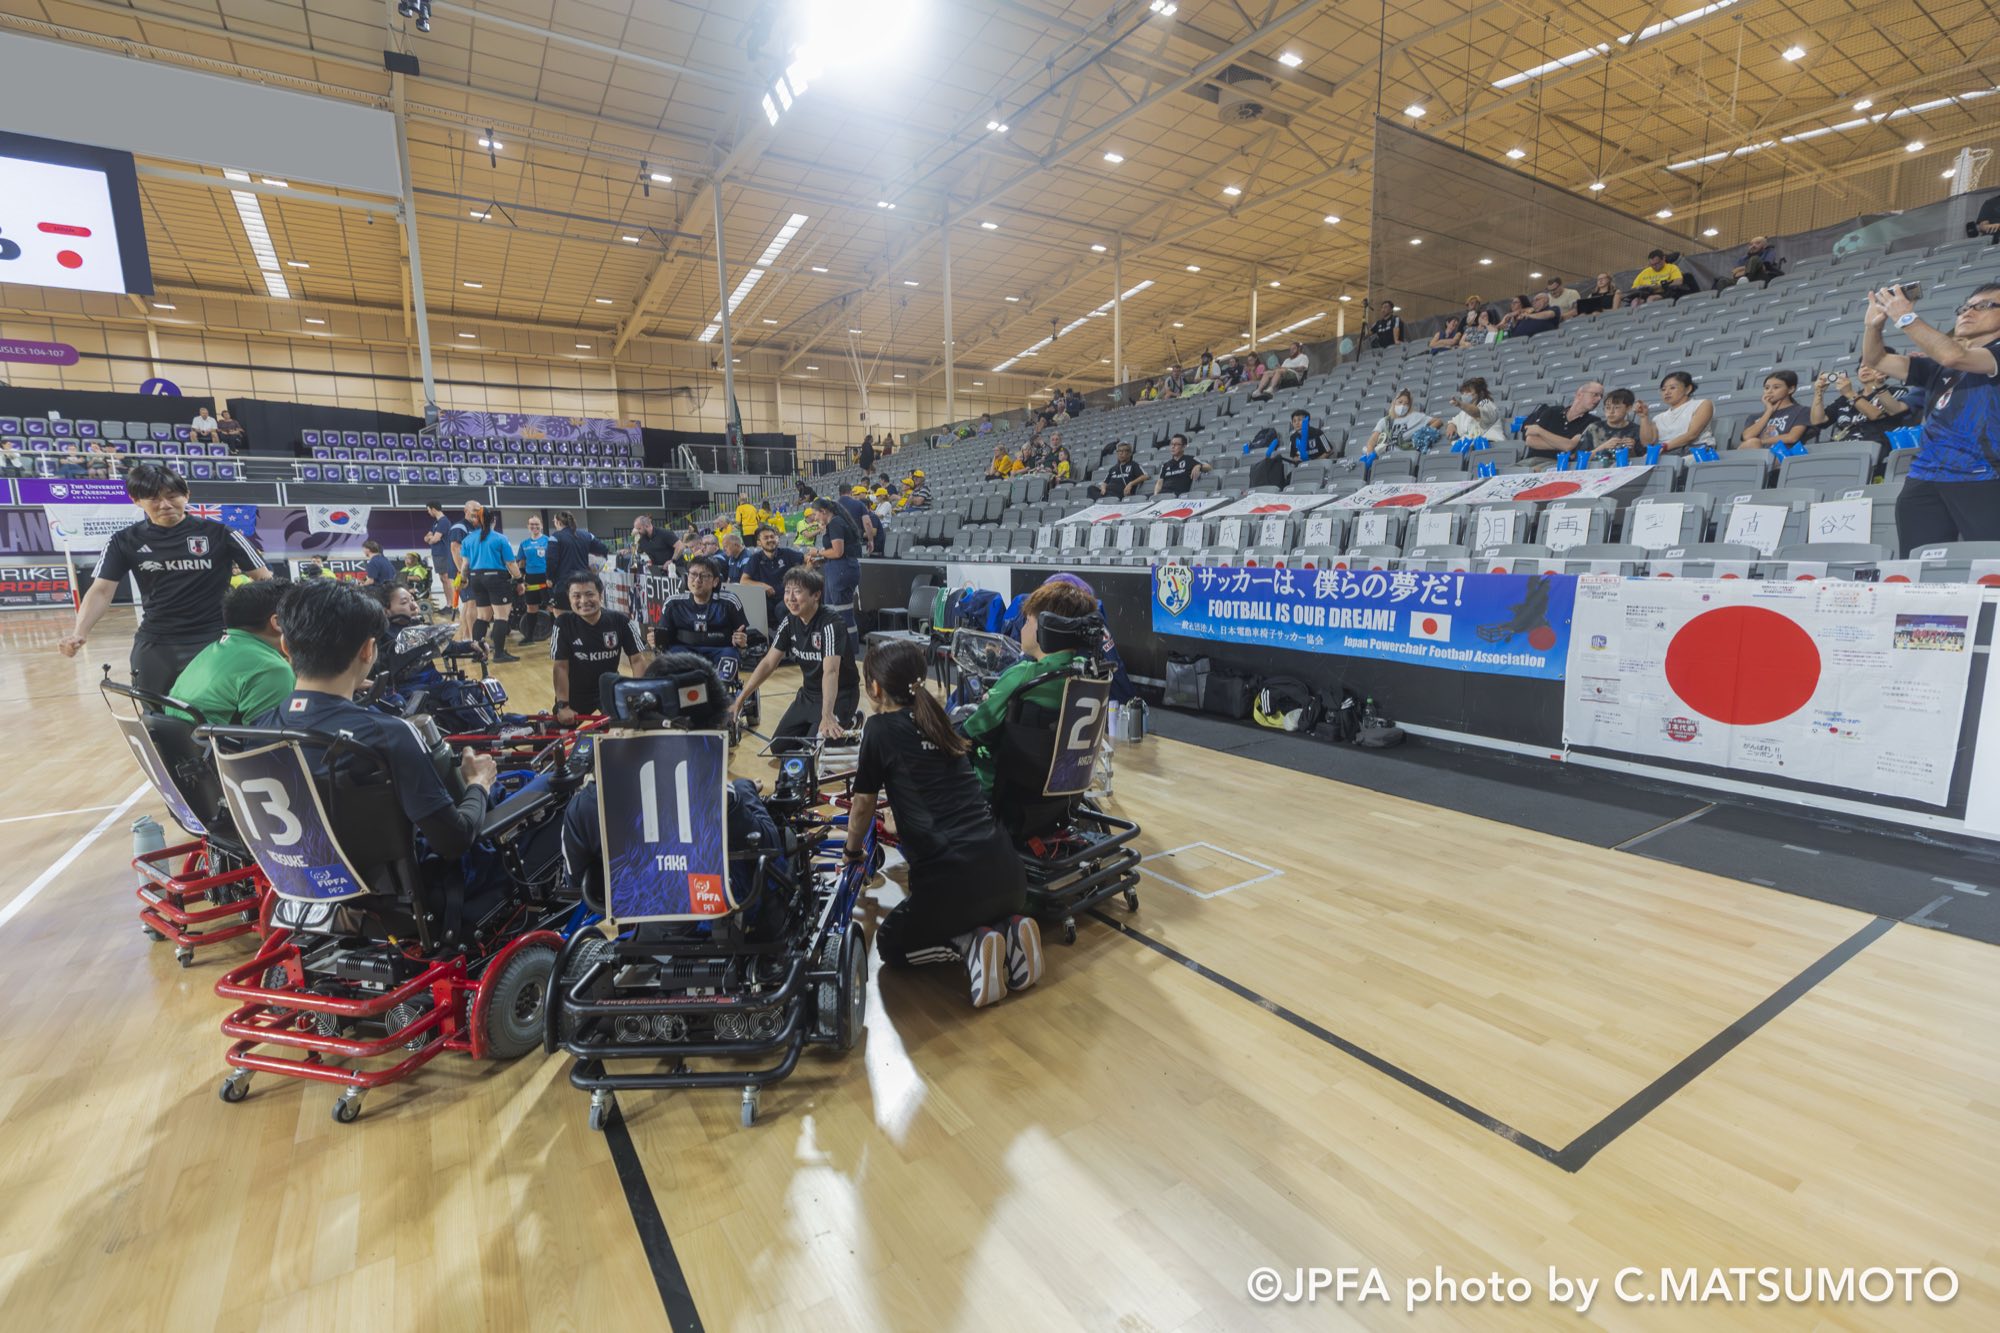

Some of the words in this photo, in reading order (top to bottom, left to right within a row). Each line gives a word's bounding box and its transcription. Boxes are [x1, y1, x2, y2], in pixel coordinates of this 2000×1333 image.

[28, 347, 65, 358] 104-107
[1553, 514, 1583, 537] 再
[165, 559, 213, 571] KIRIN
[1163, 566, 1187, 577] JPFA
[1198, 567, 1465, 607] サッカーは、僕らの夢だ！
[1208, 599, 1272, 623] FOOTBALL
[1275, 602, 1291, 623] IS
[1293, 605, 1326, 627] OUR
[1328, 608, 1396, 632] DREAM!
[589, 650, 619, 662] KIRIN
[1343, 635, 1368, 650] Japan
[1369, 638, 1427, 656] Powerchair
[1428, 645, 1473, 662] Football
[1473, 650, 1546, 668] Association
[723, 660, 734, 673] 21
[1066, 697, 1109, 750] 2
[222, 772, 302, 846] 13
[640, 760, 693, 843] 11
[655, 855, 688, 872] TAKA
[316, 876, 348, 888] FIPFA
[696, 893, 721, 903] FIPFA
